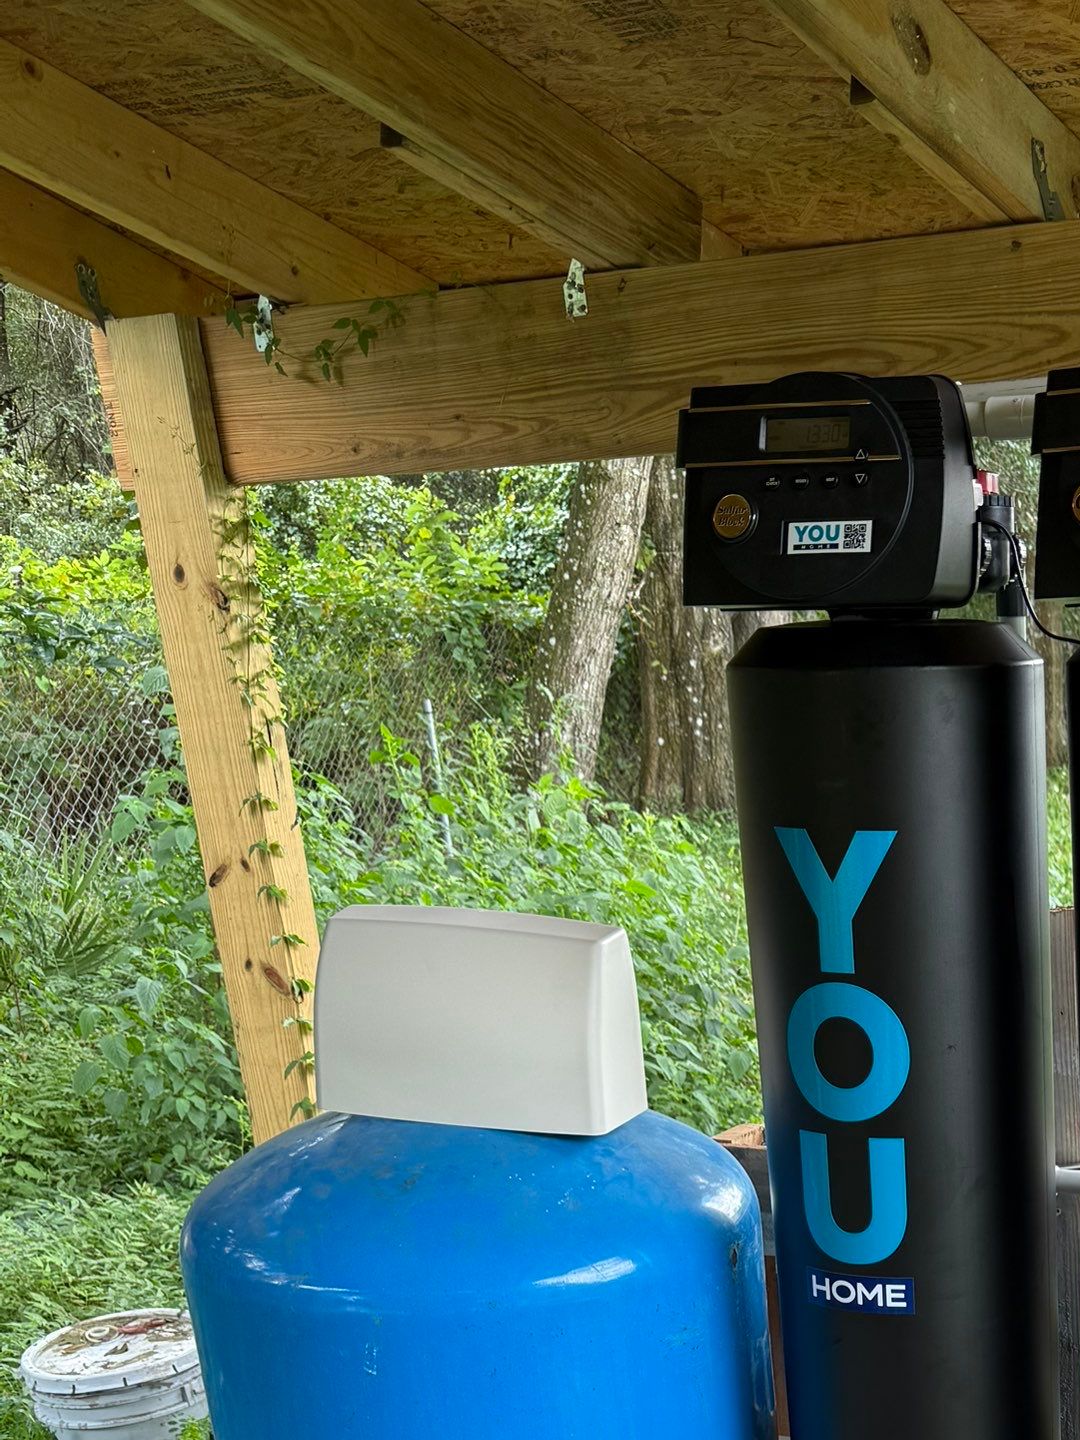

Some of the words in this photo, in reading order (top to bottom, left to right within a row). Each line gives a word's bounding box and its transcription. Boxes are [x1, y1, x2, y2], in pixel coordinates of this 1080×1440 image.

[718, 504, 749, 518] Sulfur
[794, 524, 841, 542] YOU
[774, 826, 910, 1265] YOU
[811, 1274, 907, 1309] HOME
